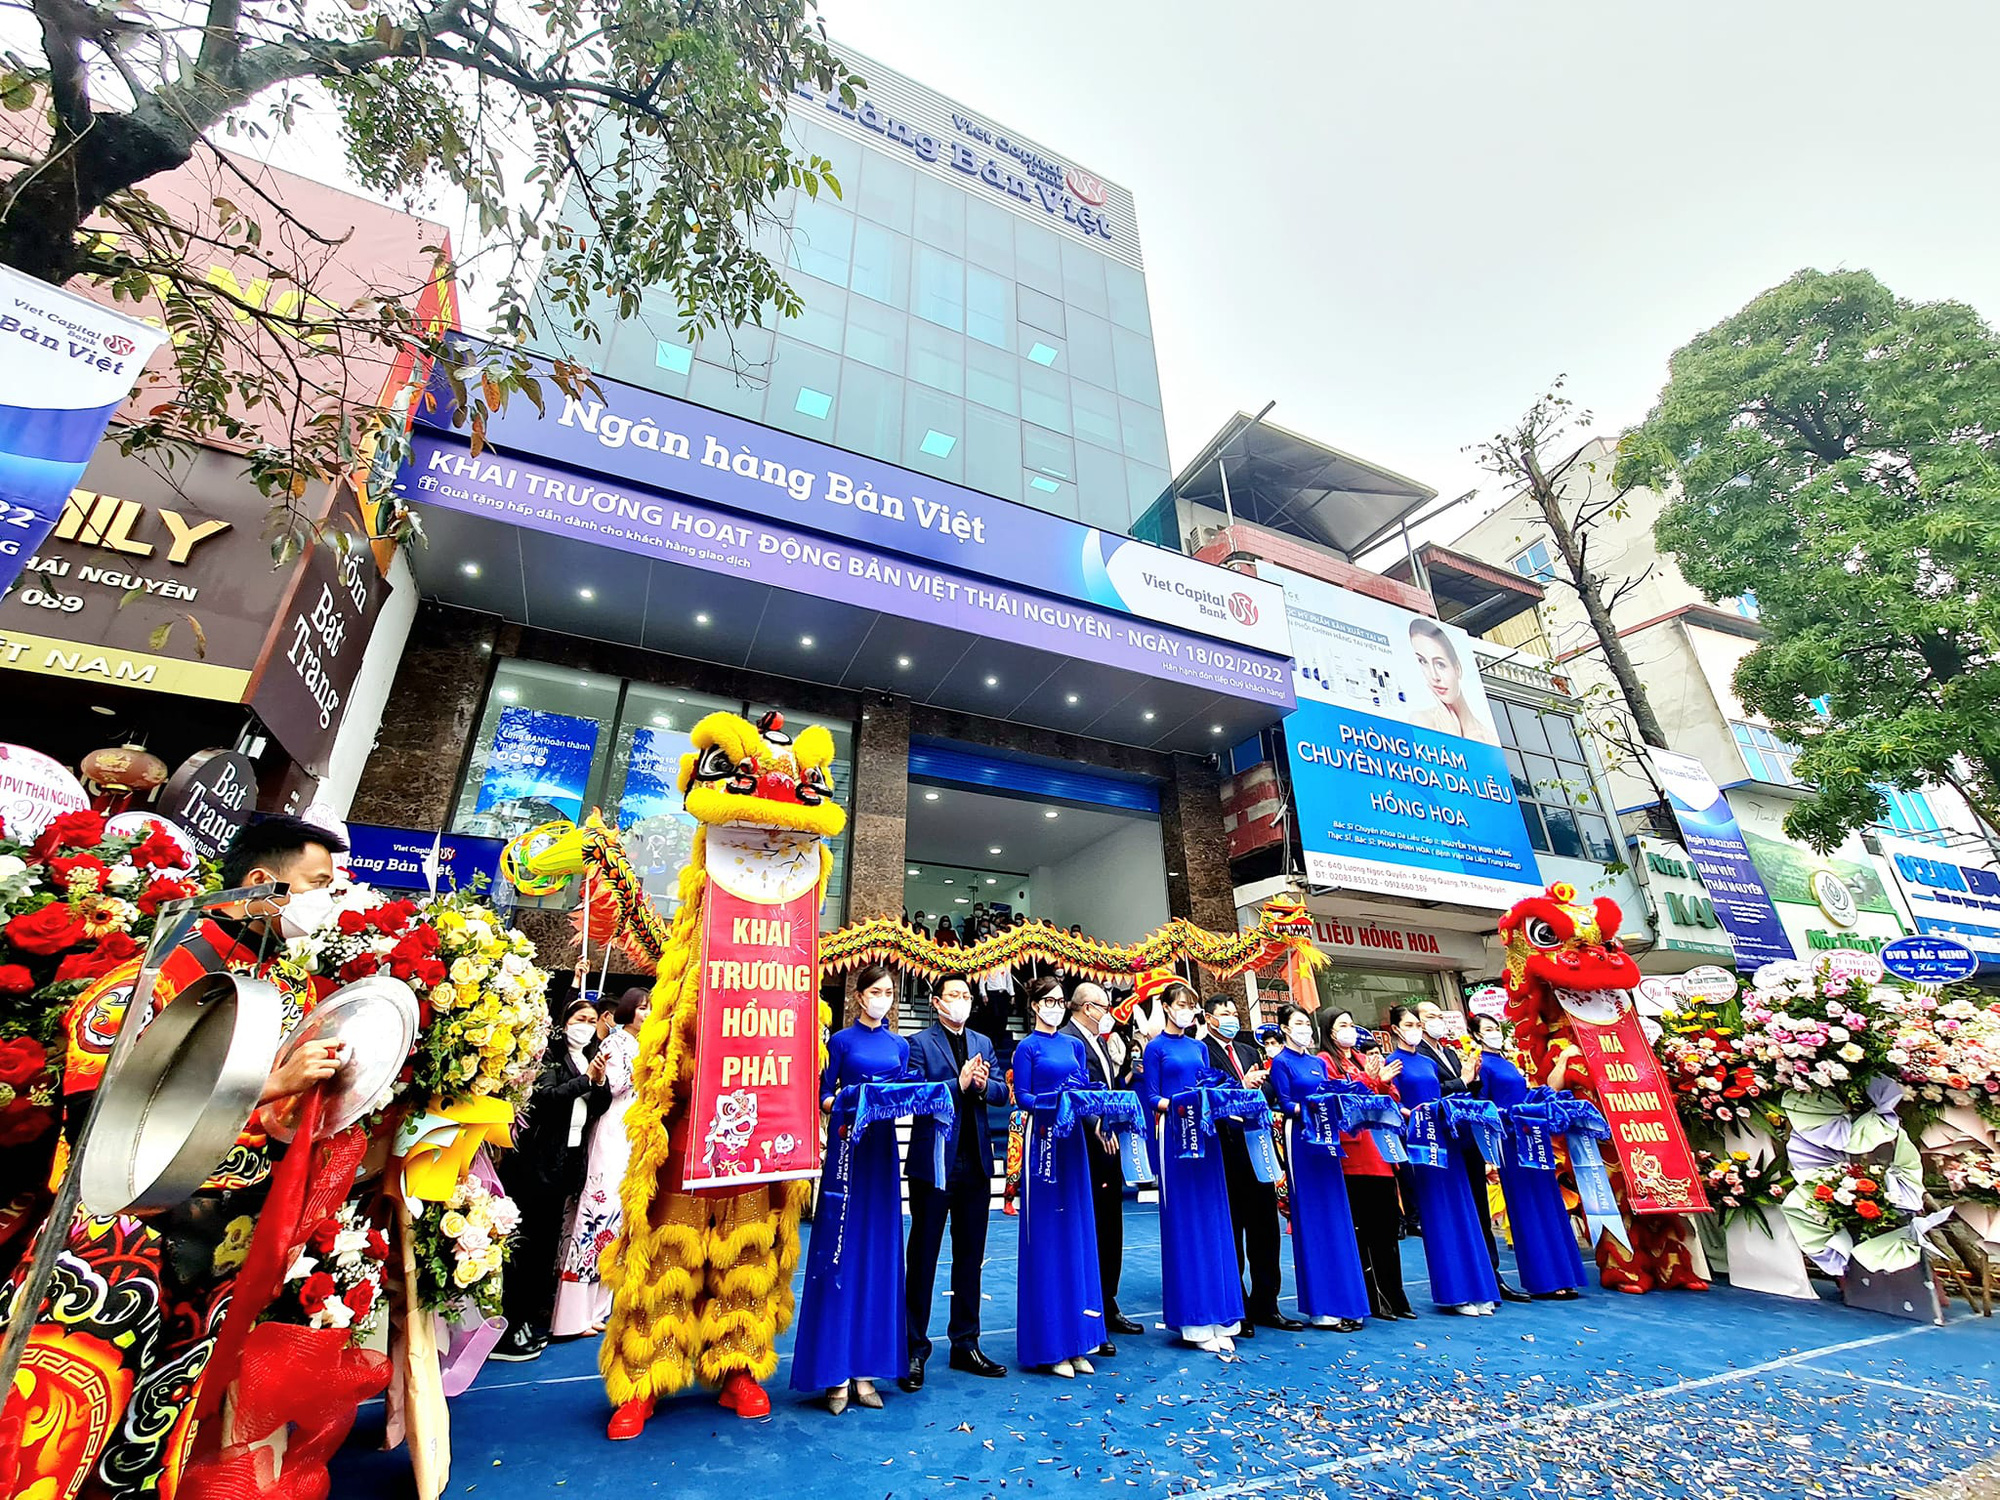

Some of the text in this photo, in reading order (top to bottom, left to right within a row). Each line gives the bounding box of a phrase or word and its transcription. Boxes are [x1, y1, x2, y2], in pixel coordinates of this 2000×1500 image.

[951, 113, 992, 147] Viet
[950, 142, 1032, 204] Bản
[1035, 182, 1112, 240] Việt
[14, 298, 102, 340] Viet Capital
[0, 314, 124, 375] Bản Việt
[67, 329, 97, 346] Bank
[558, 394, 985, 544] Ngân hàng Bản Việt
[440, 484, 751, 569] Quà tặng hấp dẫn dành cho khách hàng giao dịch
[428, 449, 518, 490] KHAI
[524, 472, 664, 527] TRƯƠNG
[671, 511, 752, 549] HOẠT
[758, 533, 841, 571] ĐỘNG
[848, 557, 901, 588] BẢN
[906, 570, 960, 602] VIỆT
[963, 586, 1017, 617] THÁI
[1023, 602, 1112, 640] NGUYÊN
[1127, 629, 1180, 657] NGÀY
[1184, 644, 1284, 684] 18/02/2022
[78, 565, 199, 602] NGUYÊN
[1141, 572, 1226, 609] Viet Capital
[1199, 602, 1228, 621] Bank
[45, 649, 158, 683] NAM
[1179, 666, 1198, 678] hạnh
[1230, 678, 1244, 690] Quý
[566, 739, 591, 751] thành
[1339, 724, 1469, 771] PHÒNG KHÁM
[1297, 740, 1513, 805] CHUYÊN KHOA DA LIỄU
[1370, 789, 1469, 828] HỒNG HOA
[1354, 824, 1379, 836] Chuyên
[1380, 829, 1396, 838] Khoa
[386, 857, 419, 873] Bản
[392, 844, 409, 853] Viet
[1327, 861, 1342, 870] 640
[732, 917, 791, 948] KHAI
[1315, 917, 1441, 954] LIỄU HỒNG HOA
[1885, 947, 1969, 960] BVB BẮC NINH
[708, 959, 812, 992] TRƯƠNG
[721, 997, 795, 1038] HỒNG
[1598, 1031, 1625, 1054] MÃ
[721, 1050, 793, 1088] PHÁT
[1604, 1058, 1639, 1083] ĐÁO
[1318, 1101, 1329, 1123] Việt
[1604, 1089, 1663, 1113] THÀNH
[1186, 1104, 1199, 1151] Bản Việt
[1323, 1123, 1333, 1145] Bản
[1426, 1121, 1437, 1141] Bản
[1619, 1118, 1670, 1143] CÔNG
[1534, 1125, 1547, 1165] Bản Việt
[1044, 1151, 1052, 1178] Bản
